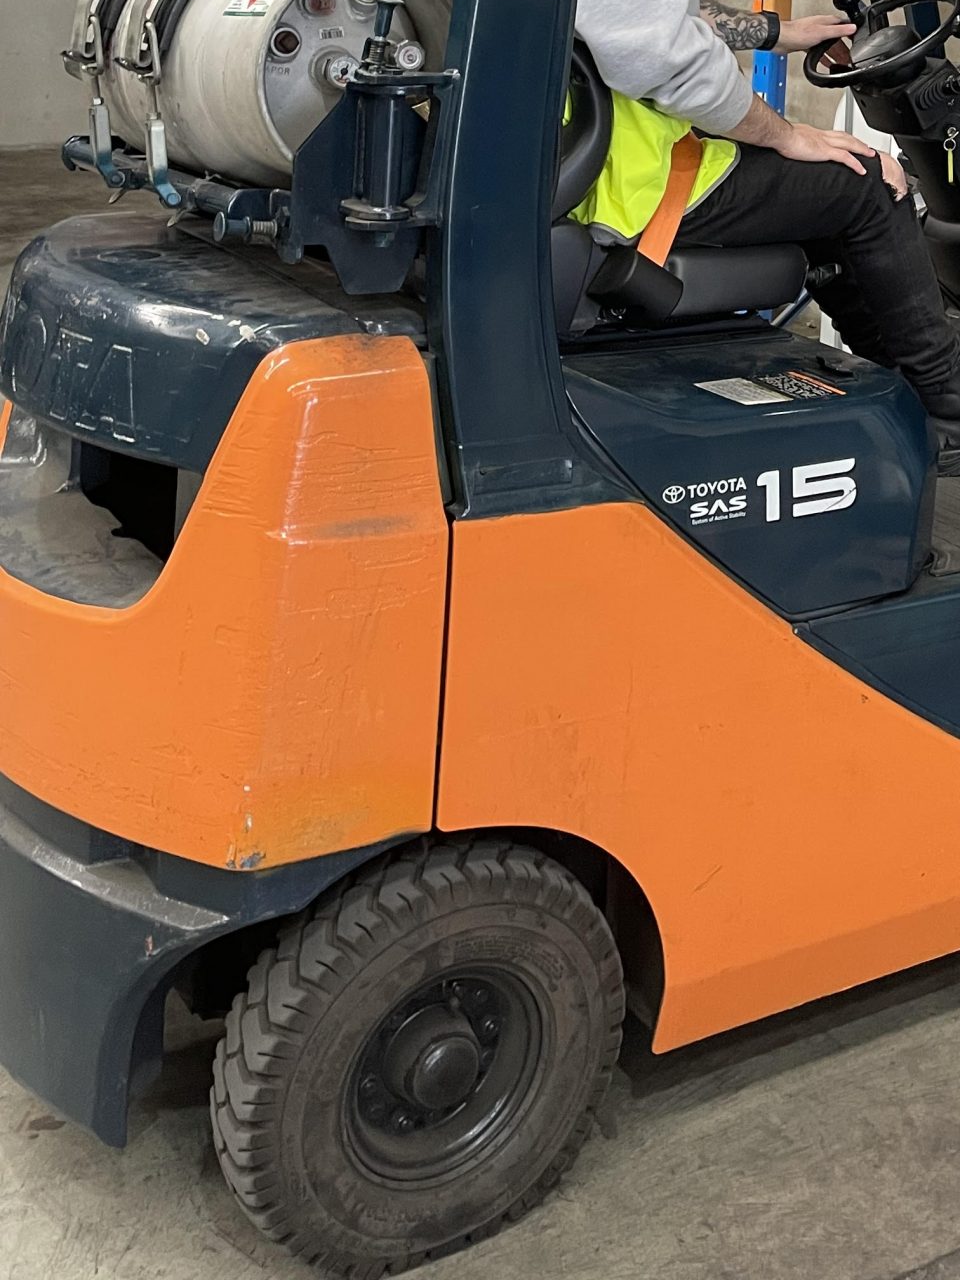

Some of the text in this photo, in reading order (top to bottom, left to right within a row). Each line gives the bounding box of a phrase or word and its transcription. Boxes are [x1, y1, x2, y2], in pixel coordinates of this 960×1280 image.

[687, 458, 856, 522] TOYOTA 15
[690, 495, 747, 518] SAS
